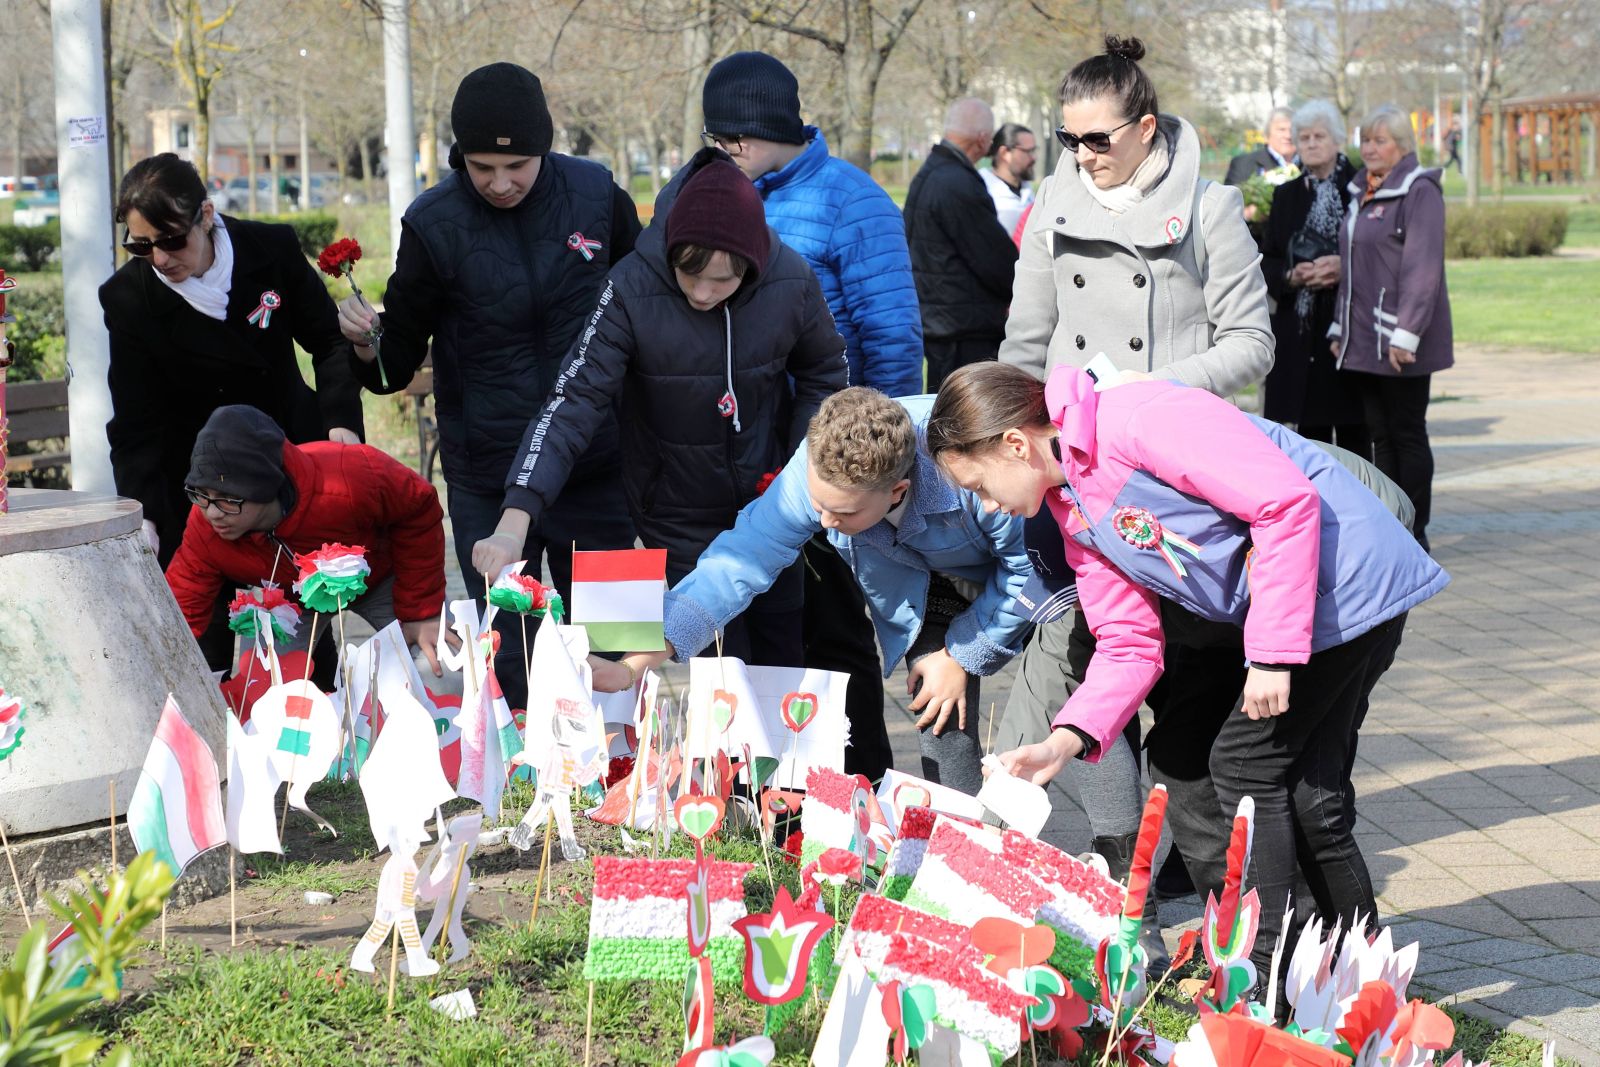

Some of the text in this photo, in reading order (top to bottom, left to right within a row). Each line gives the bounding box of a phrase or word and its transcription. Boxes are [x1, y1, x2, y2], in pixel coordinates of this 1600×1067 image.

[530, 433, 544, 451] STAY
[555, 374, 568, 394] STAY
[590, 305, 604, 325] STAY
